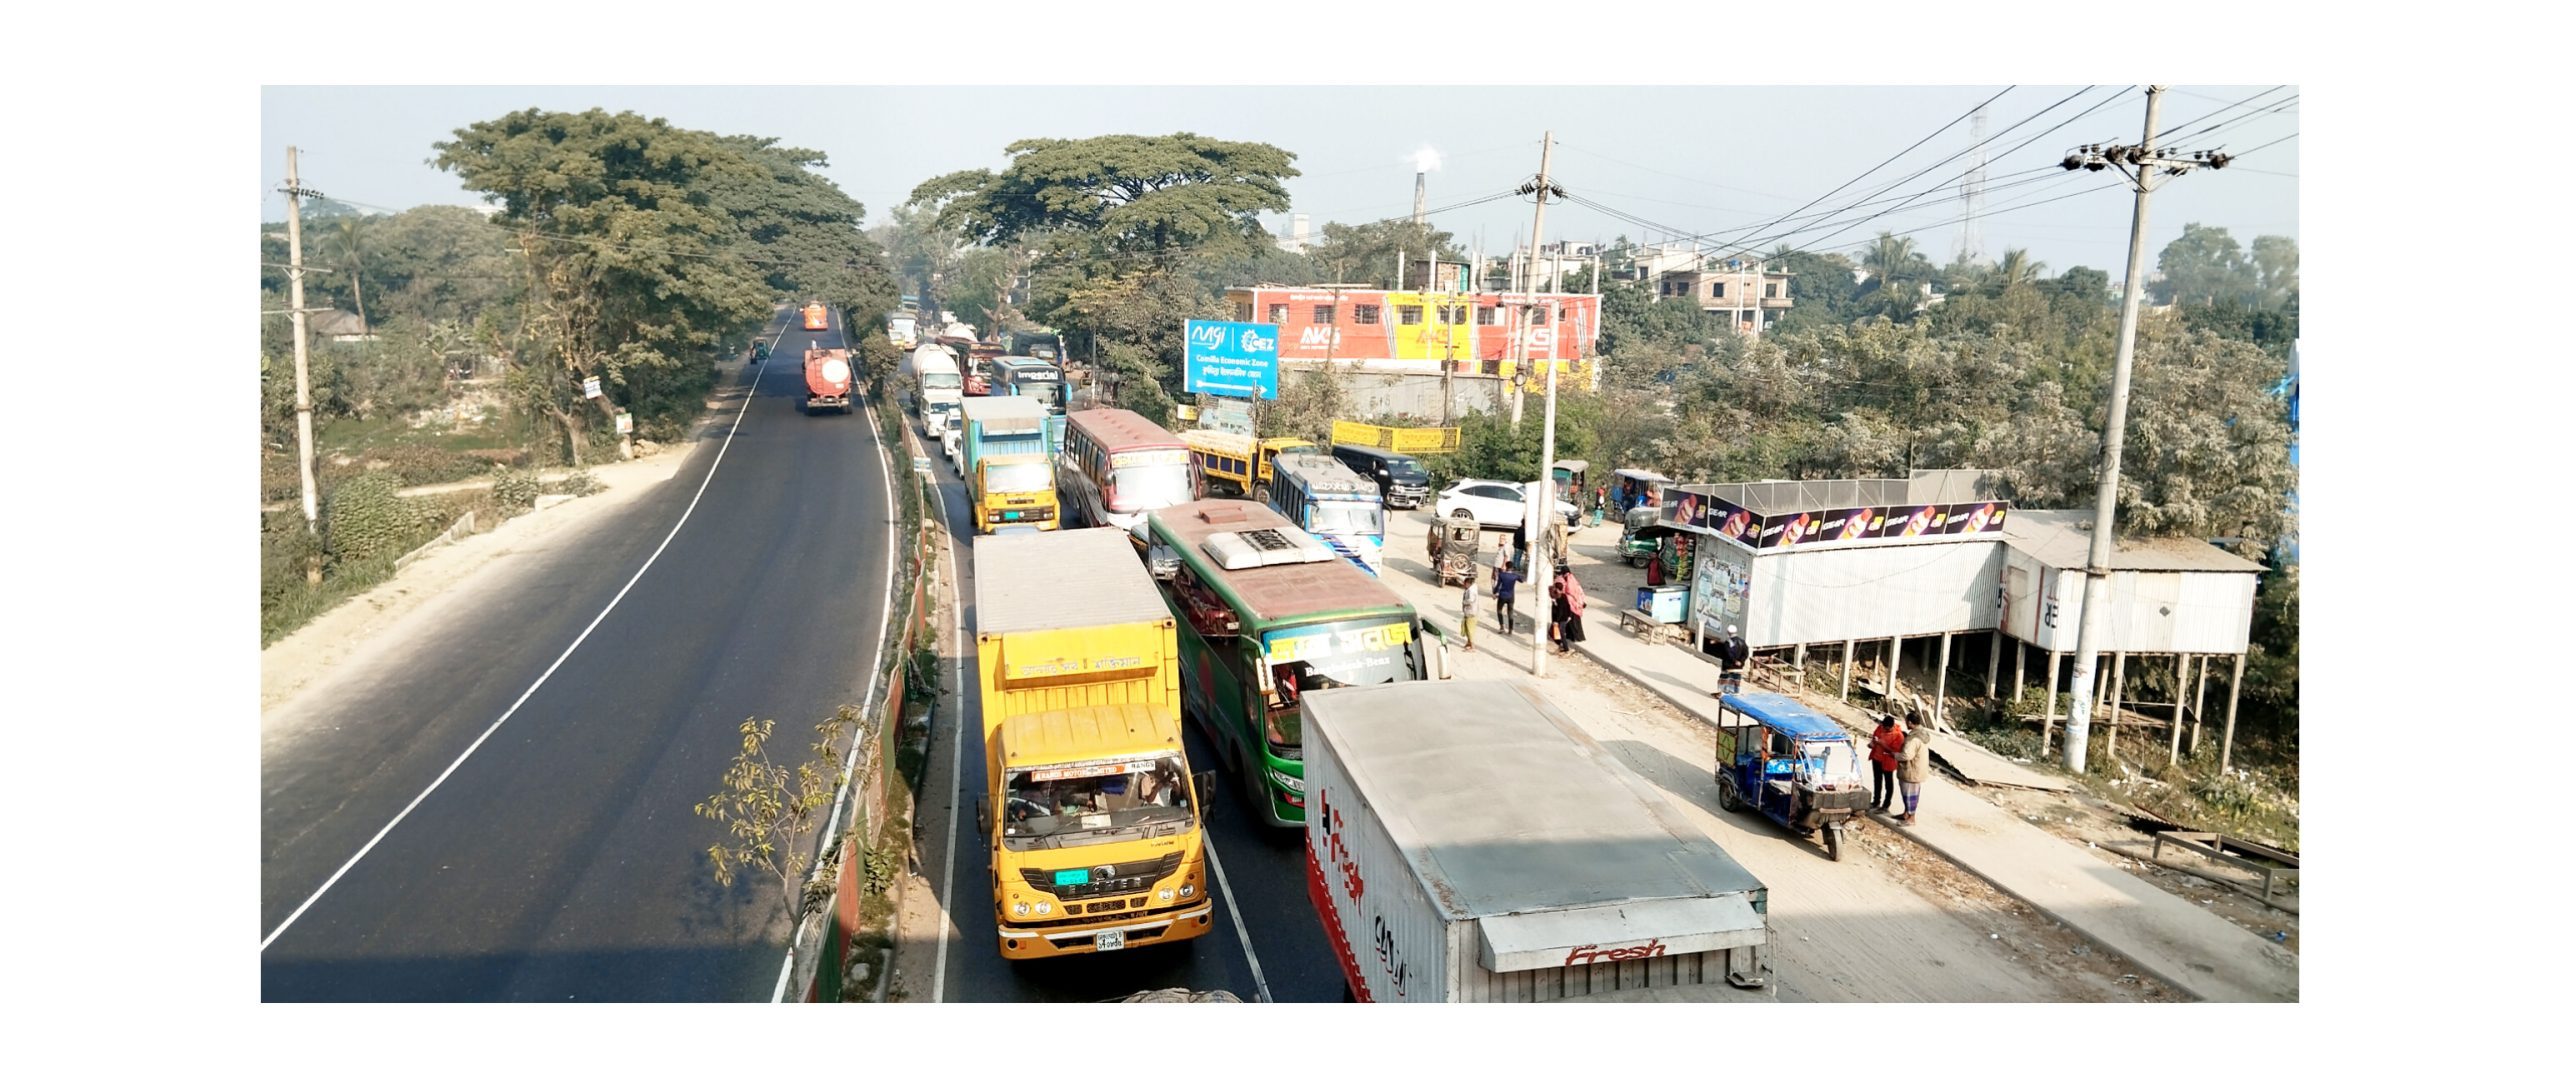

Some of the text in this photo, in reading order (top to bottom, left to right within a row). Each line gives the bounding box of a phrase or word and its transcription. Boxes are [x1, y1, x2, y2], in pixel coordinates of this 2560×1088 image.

[1196, 354, 1268, 367] Comilla Economic Zone
[1708, 507, 1728, 518] GEAR
[1949, 512, 1970, 524] GEAR
[1822, 519, 1846, 530] GEAR
[1886, 515, 1909, 527] GEAR
[1763, 524, 1784, 537] GEAR
[1565, 937, 1666, 966] Fresh
